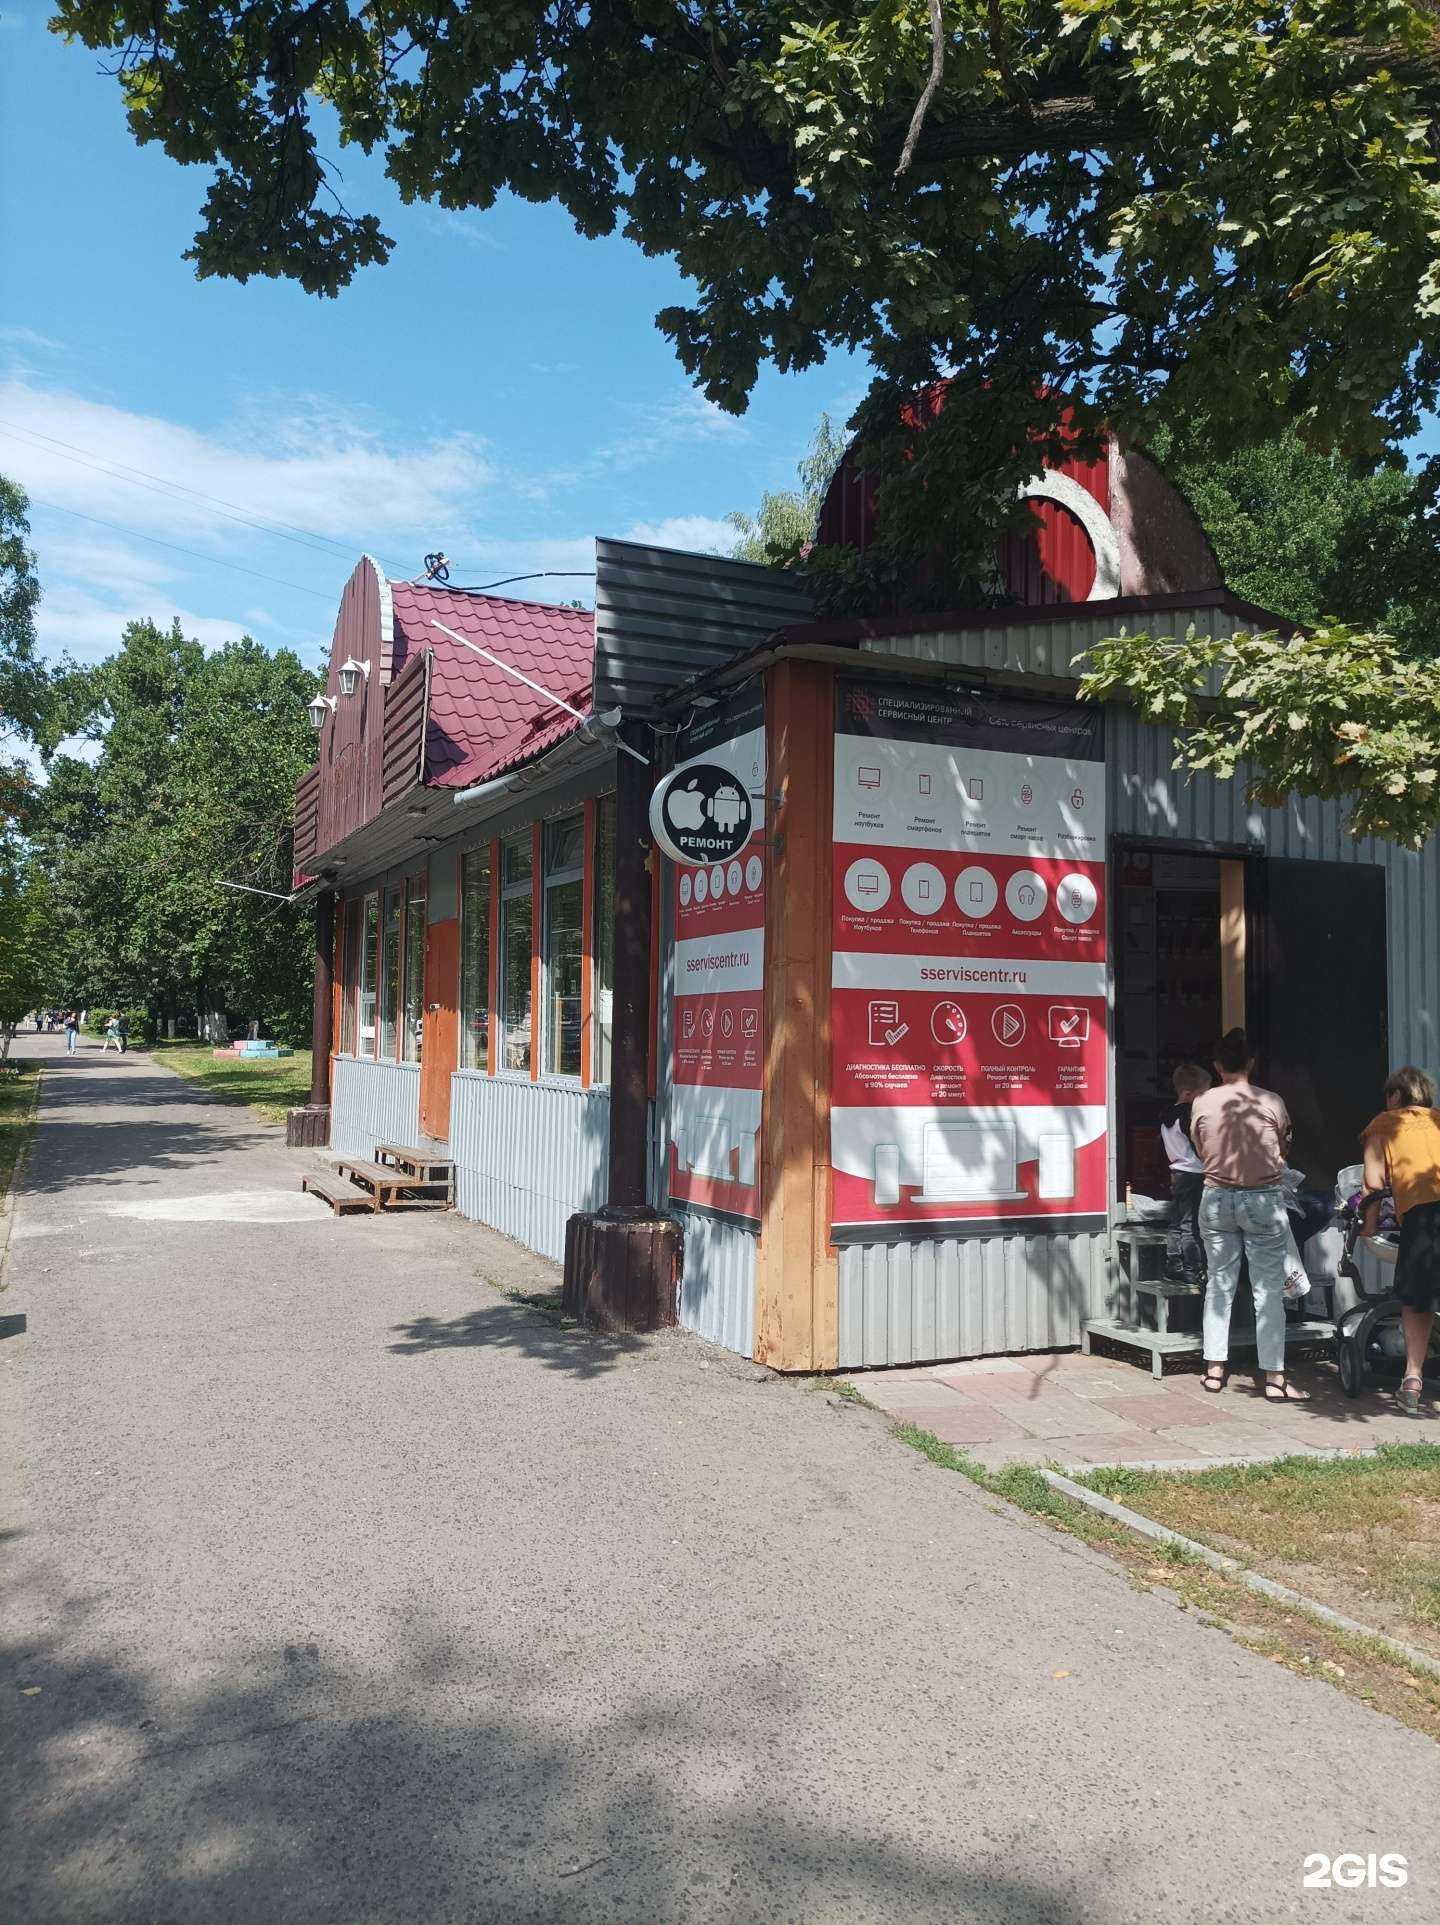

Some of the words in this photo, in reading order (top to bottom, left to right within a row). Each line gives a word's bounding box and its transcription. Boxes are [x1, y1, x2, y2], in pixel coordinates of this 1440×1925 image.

[878, 709, 926, 721] СЕРВИСНЫЙ
[927, 715, 953, 726] ЦЕНТР
[858, 811, 881, 820] Ремонт
[914, 816, 936, 825] Ремонт
[680, 836, 734, 850] РЕМОНТ
[686, 950, 750, 973] sserviscentr.ru
[920, 966, 1027, 984] sserviscentr.ru
[845, 1063, 890, 1072] ДИАГНОСТИКА
[891, 1064, 926, 1072] БЕСПЛАТНО
